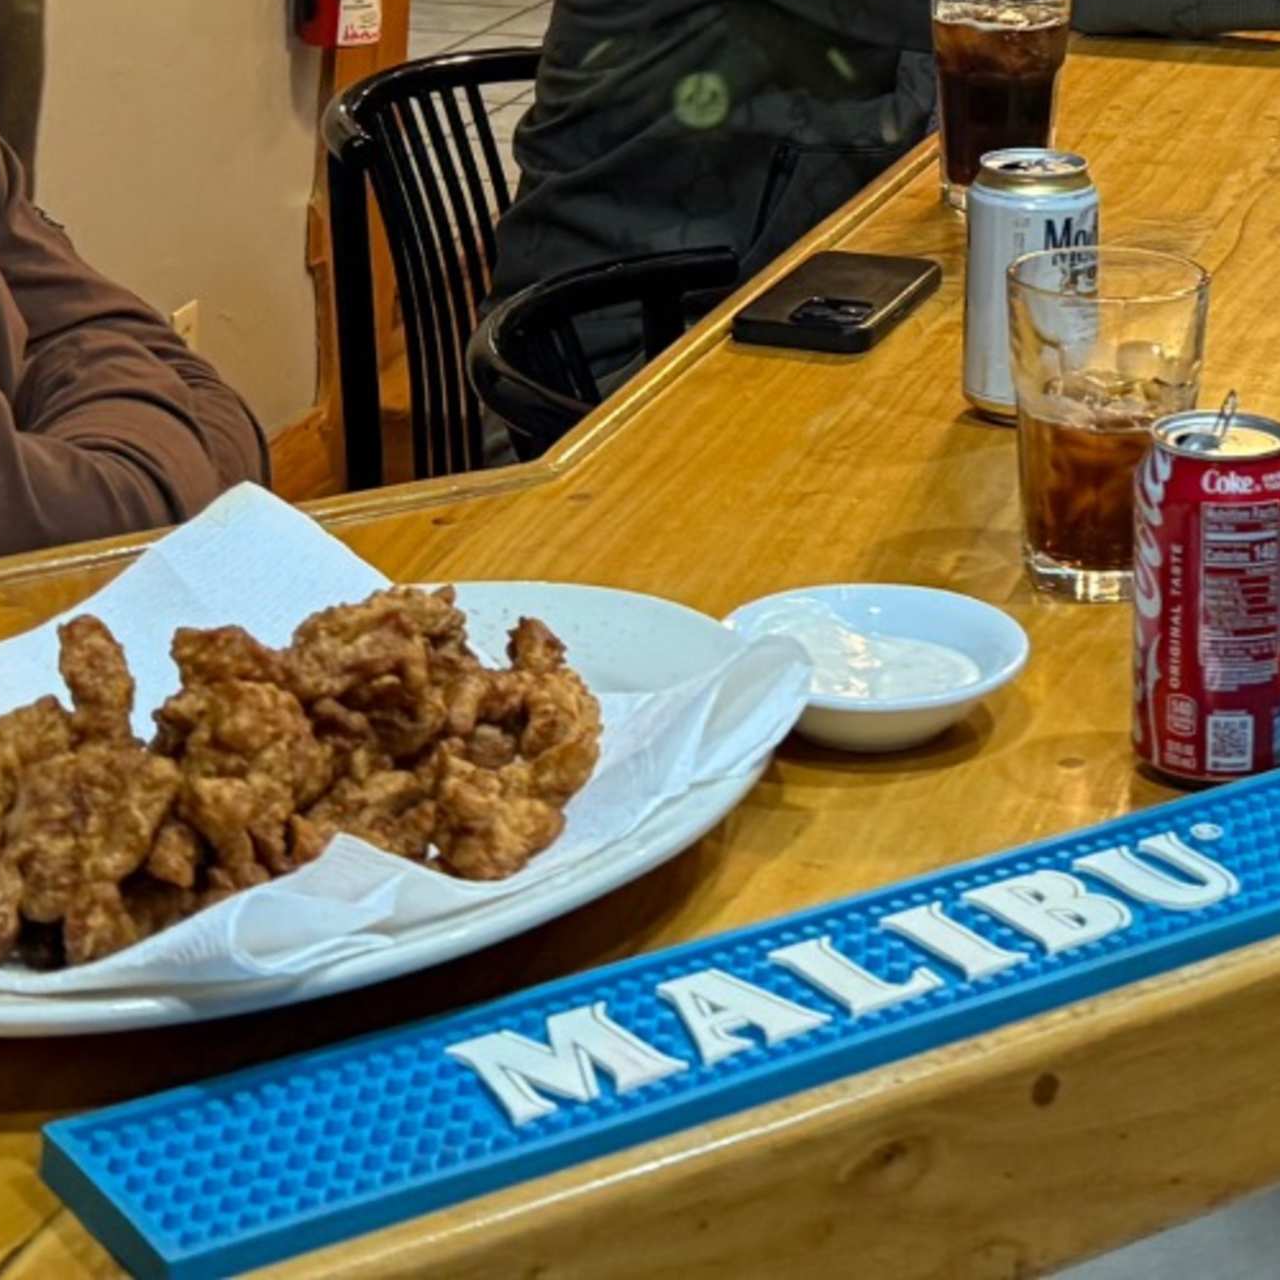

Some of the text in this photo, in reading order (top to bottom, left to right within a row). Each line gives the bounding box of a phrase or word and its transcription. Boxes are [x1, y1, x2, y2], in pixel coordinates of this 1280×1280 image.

[1201, 468, 1255, 495] Coke
[1170, 543, 1184, 596] TASTE
[1168, 605, 1182, 689] ORIGINAL
[445, 830, 1241, 1128] MALIBU
